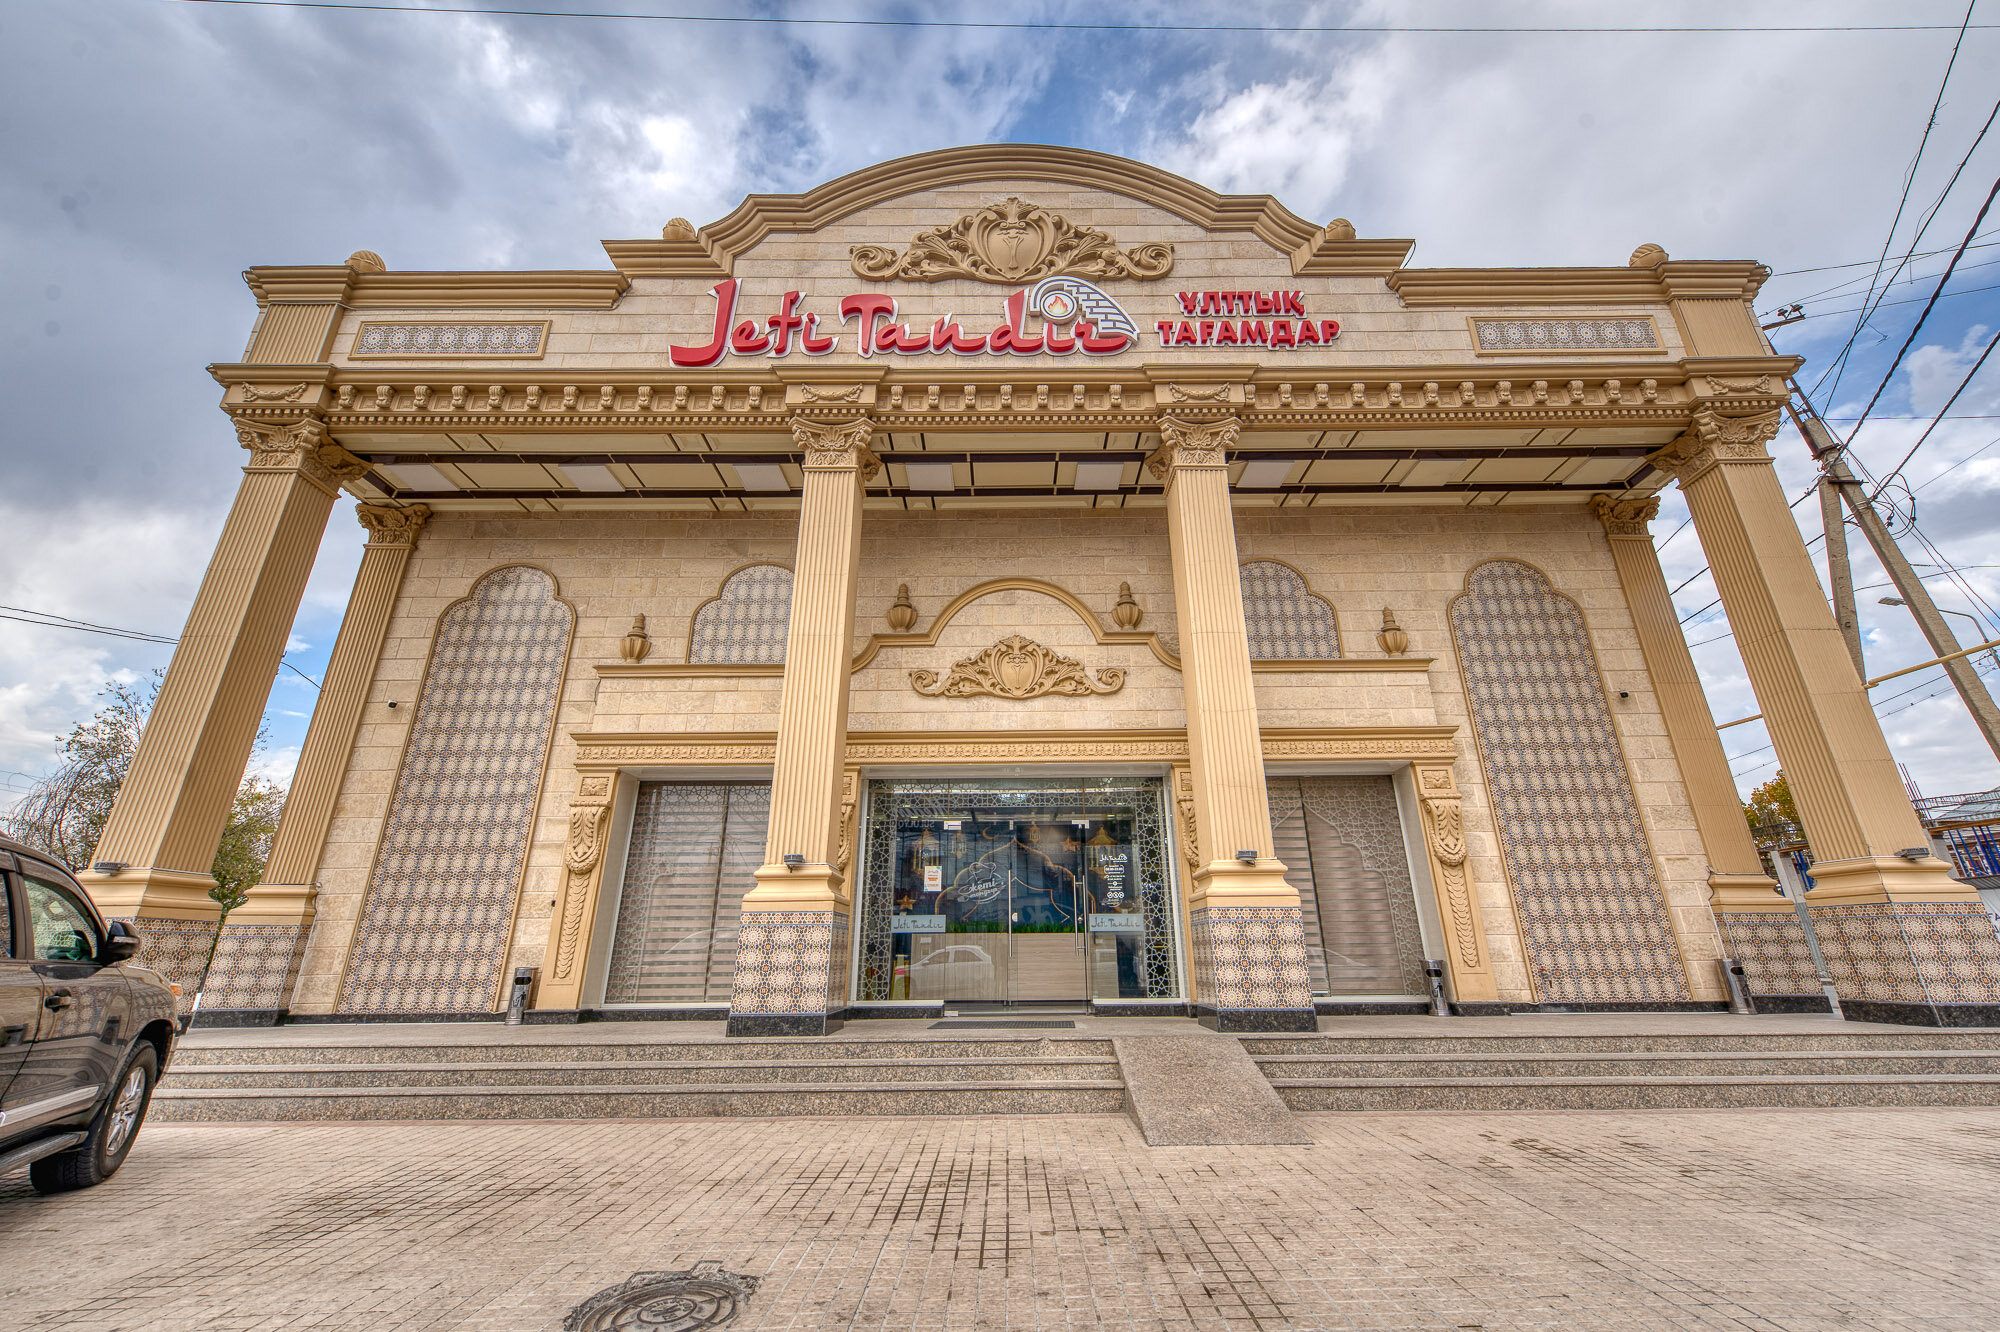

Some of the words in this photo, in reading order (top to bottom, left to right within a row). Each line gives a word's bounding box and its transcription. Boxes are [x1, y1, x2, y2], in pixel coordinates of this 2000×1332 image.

[1178, 290, 1305, 317] ҰЛТТЫҚ
[669, 277, 836, 366] Jeti
[839, 288, 1130, 356] Tandir
[1157, 320, 1340, 348] ТАҒАМДАР
[893, 919, 910, 929] Jeti
[911, 919, 943, 929] Tandir
[1091, 917, 1107, 928] Jeti
[1108, 918, 1140, 928] Tandir
